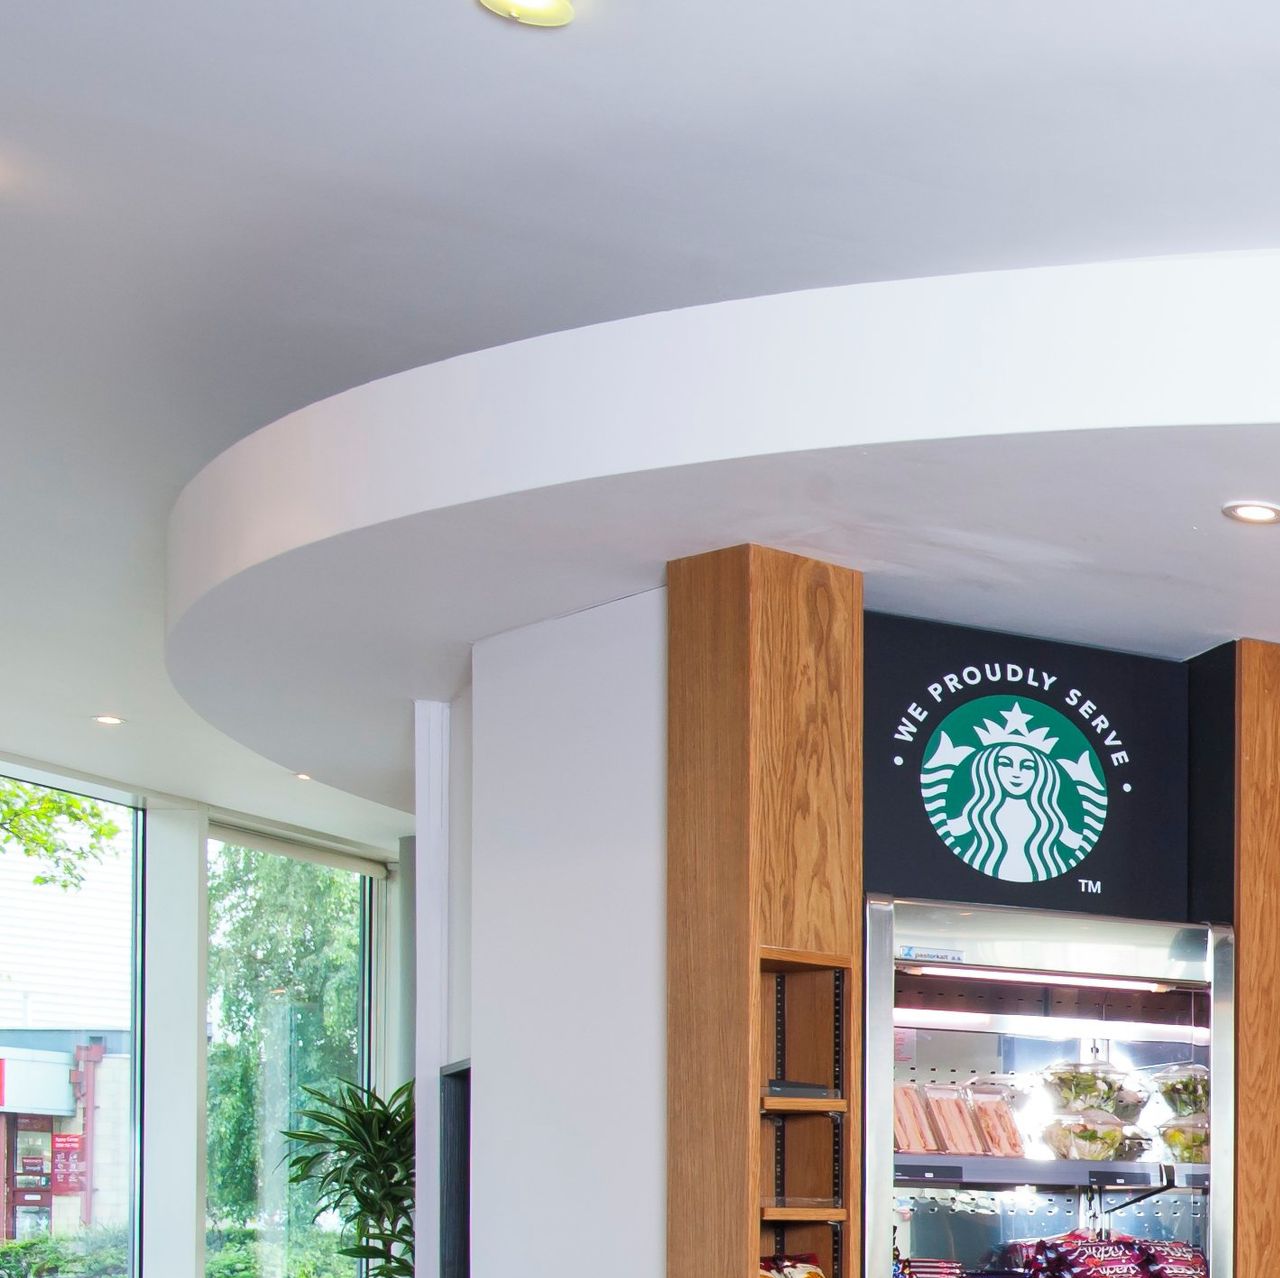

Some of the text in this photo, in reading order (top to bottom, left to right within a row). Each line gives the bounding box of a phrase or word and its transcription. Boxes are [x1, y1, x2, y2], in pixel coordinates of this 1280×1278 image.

[893, 663, 1129, 767] WE PROUDLY SERVE
[1078, 879, 1101, 893] TM
